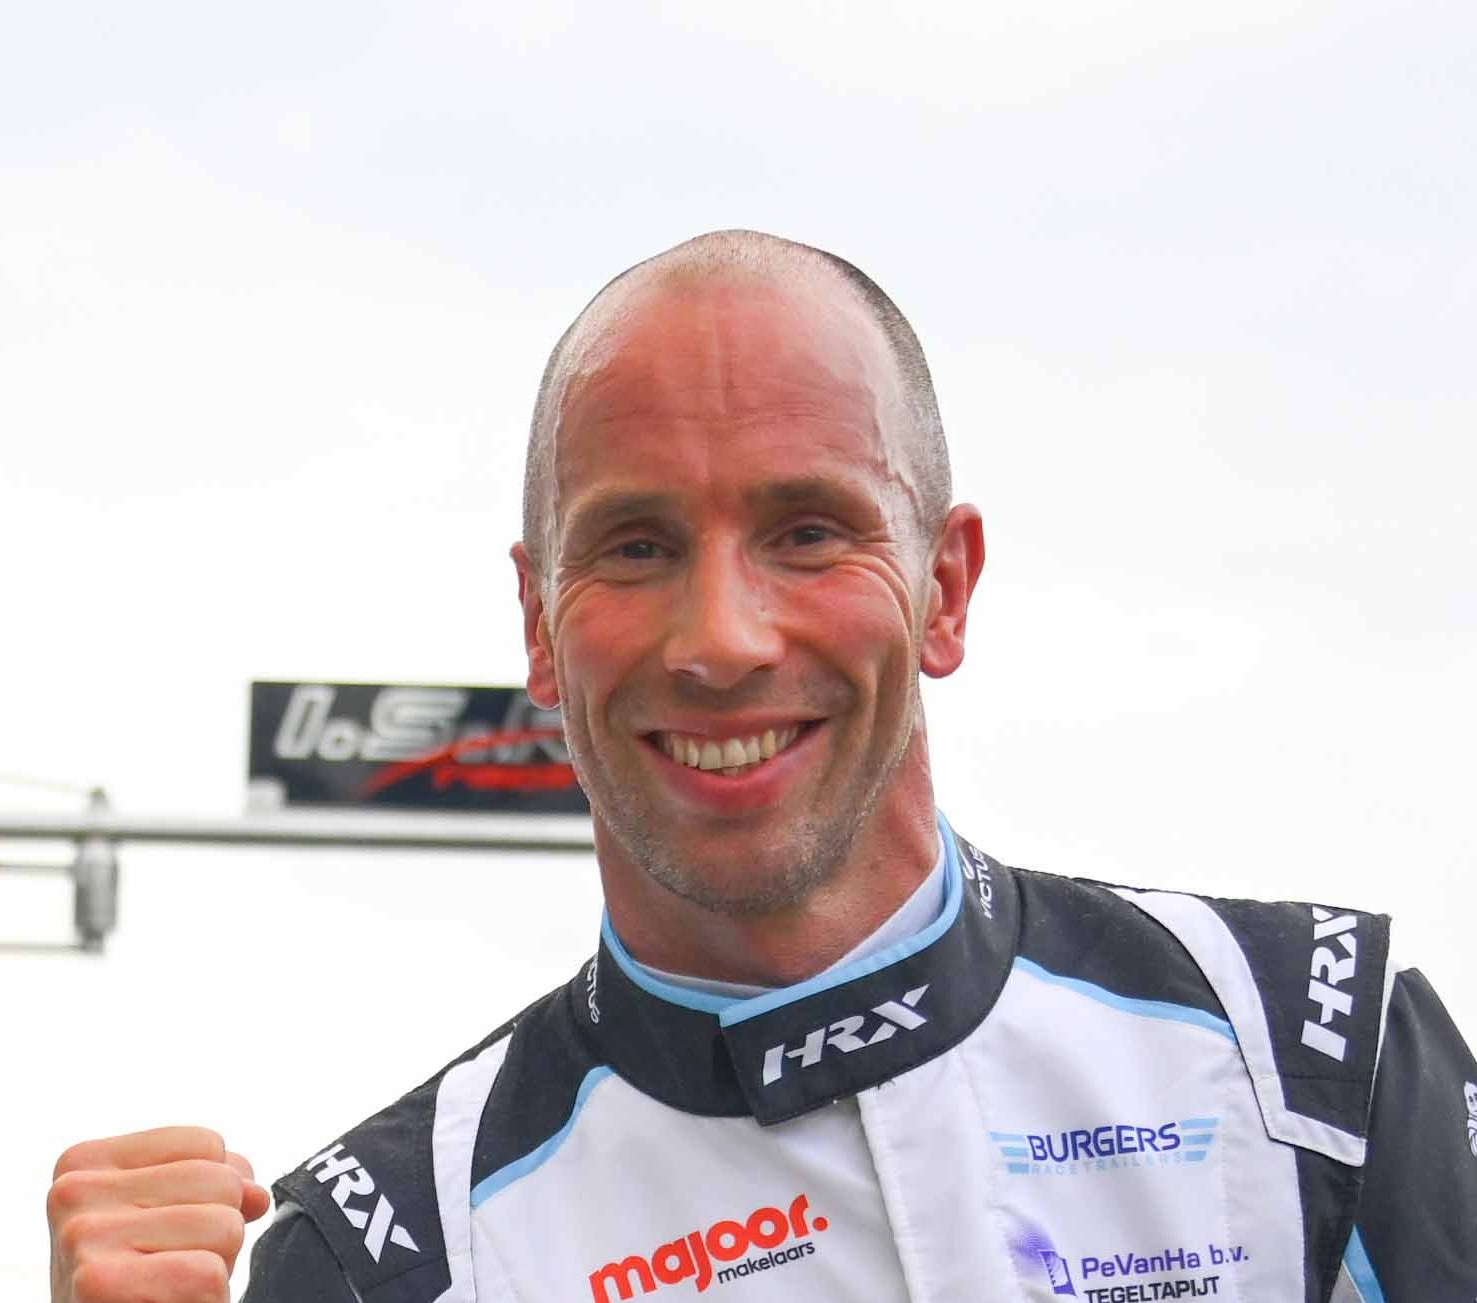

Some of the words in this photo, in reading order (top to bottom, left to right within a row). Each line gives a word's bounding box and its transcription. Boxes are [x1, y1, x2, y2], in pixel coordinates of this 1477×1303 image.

[762, 983, 930, 1087] HRX
[1027, 1122, 1181, 1163] BURGERS
[306, 1143, 420, 1265] HRX
[717, 1240, 816, 1285] makelaars
[1080, 1247, 1202, 1281] PeVanHa
[1210, 1243, 1250, 1266] b.v.
